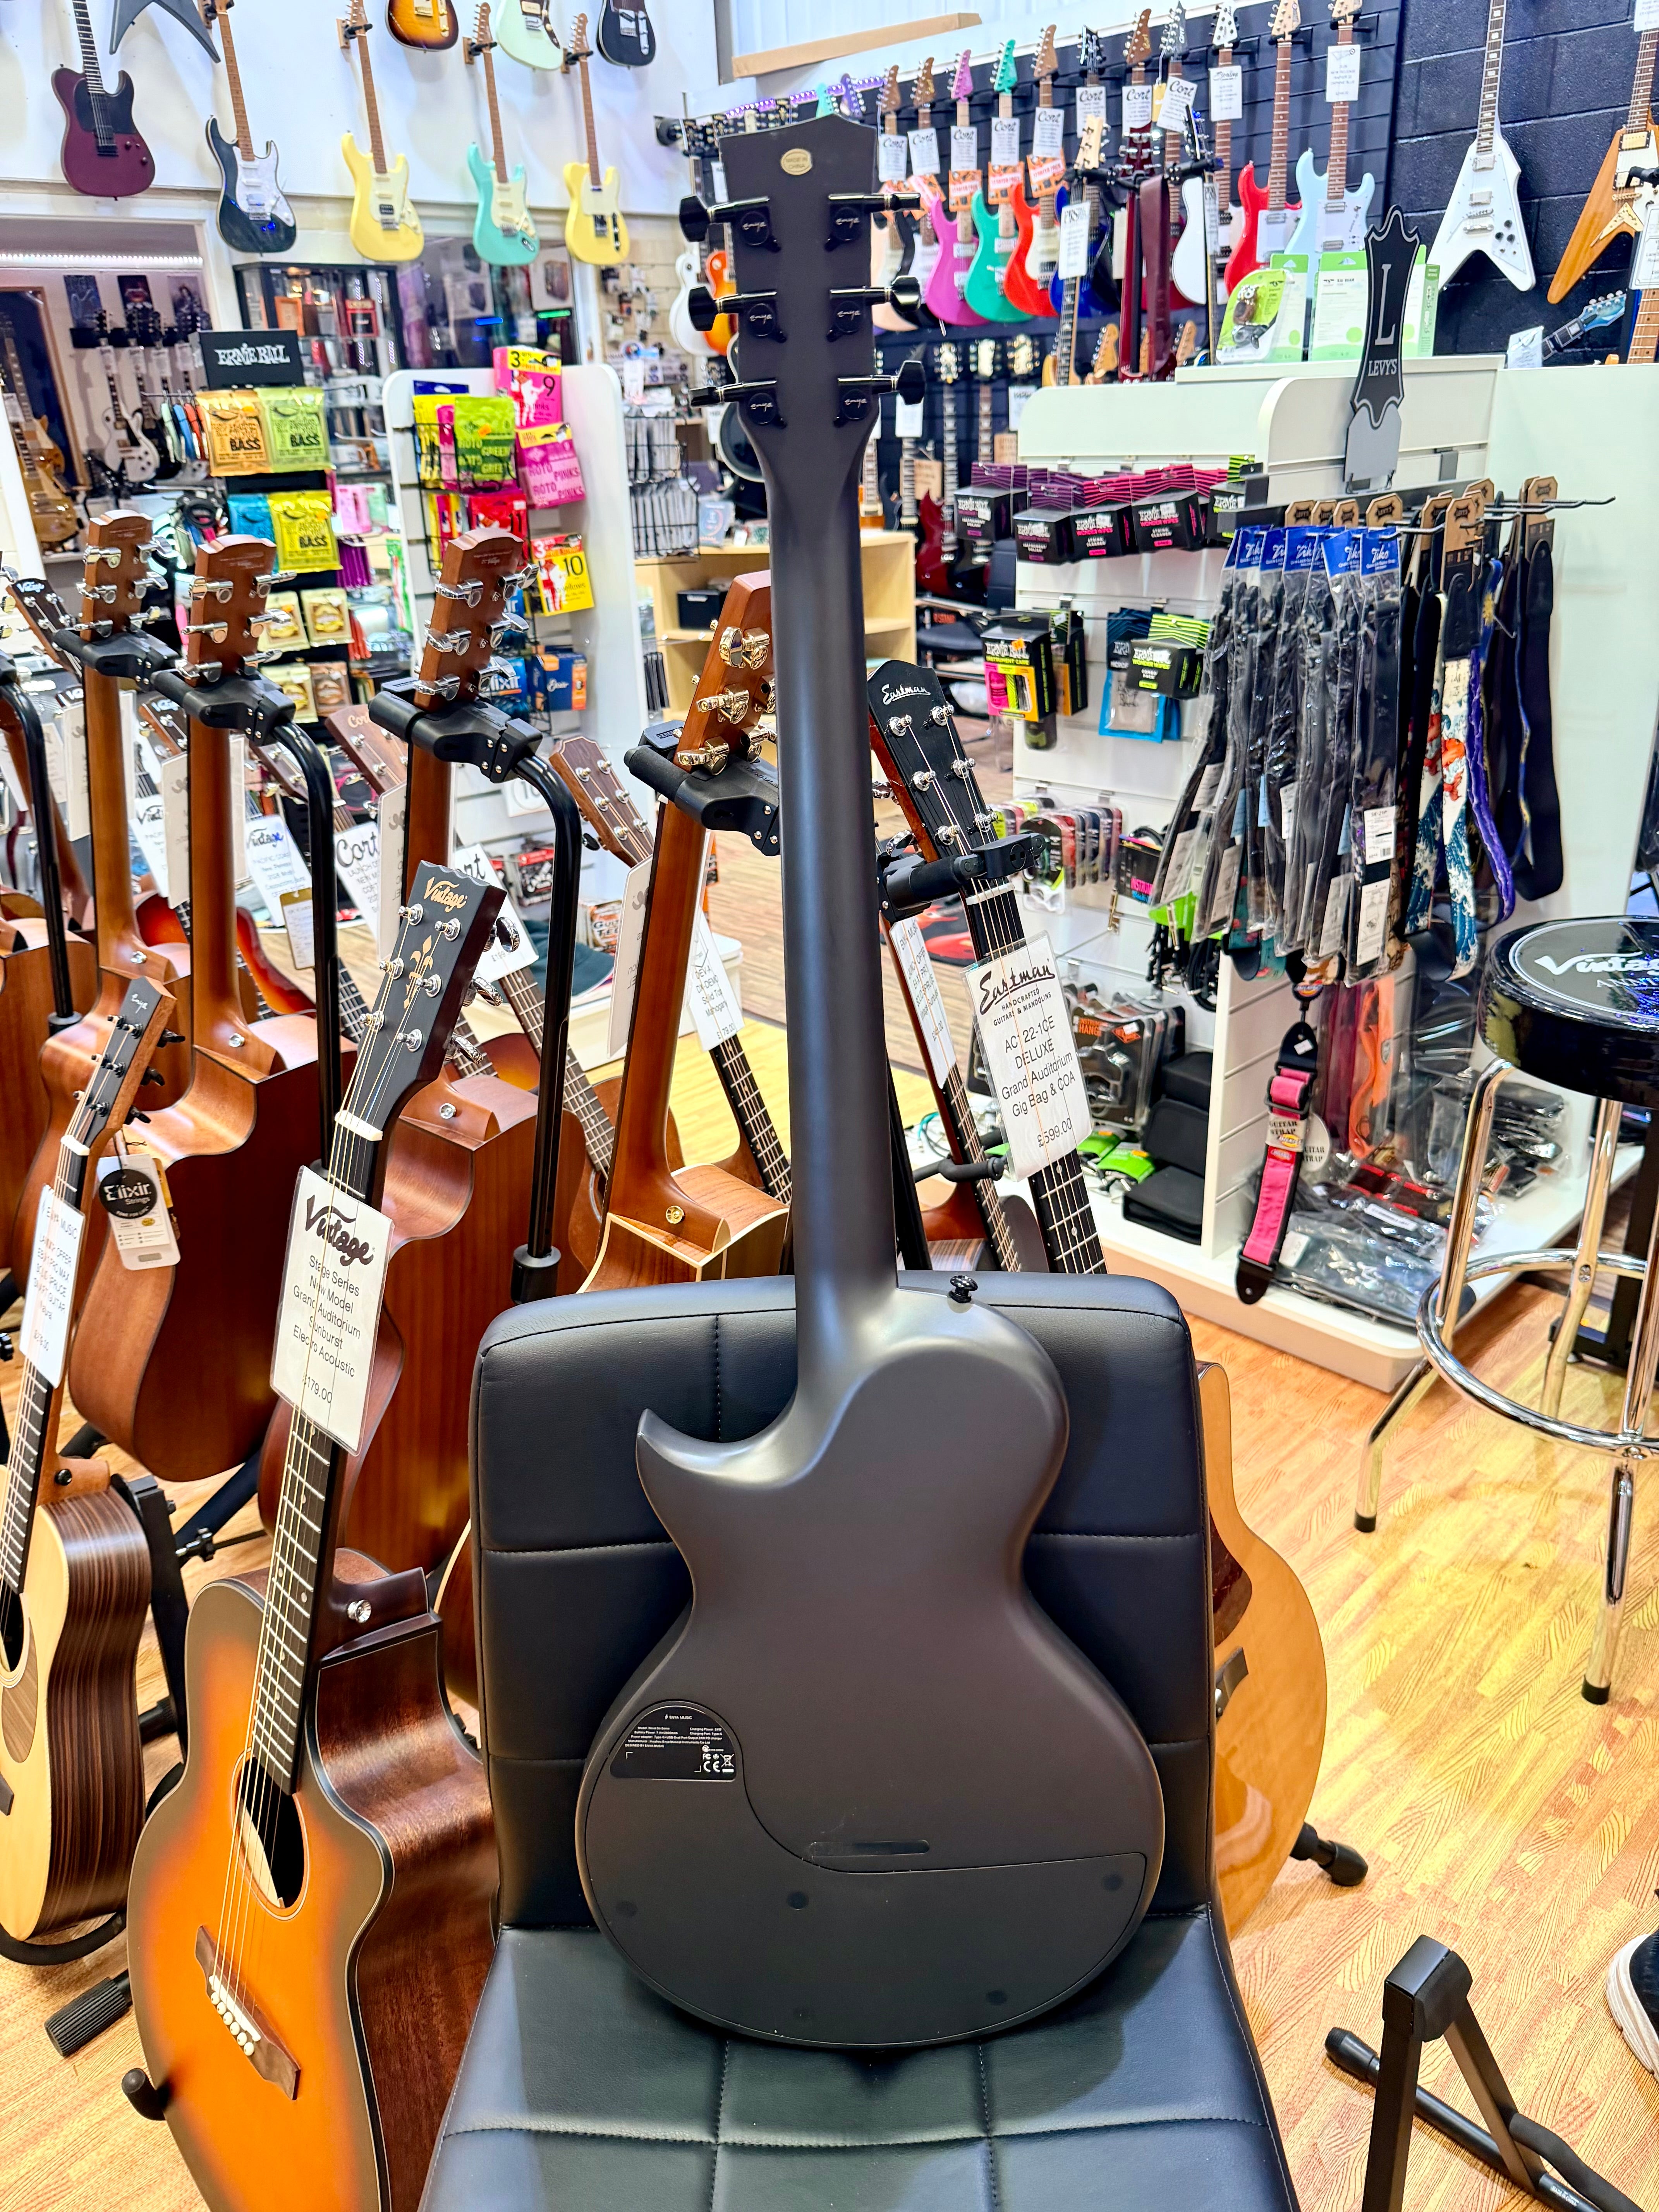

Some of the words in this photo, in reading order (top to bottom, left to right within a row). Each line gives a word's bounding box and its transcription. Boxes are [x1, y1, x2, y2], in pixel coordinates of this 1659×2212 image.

[1079, 89, 1104, 102] Cort
[1127, 88, 1150, 101] Cort
[1170, 80, 1194, 96] Cort
[994, 120, 1016, 132] Cort
[1038, 112, 1061, 122] Cort
[884, 138, 904, 148] Cort
[913, 132, 934, 145] Cort
[954, 128, 974, 141] Cort
[1375, 264, 1396, 345] L
[214, 343, 258, 366] ERNIE
[257, 344, 291, 364] BALL
[511, 351, 520, 367] 3
[1368, 359, 1398, 376] LEVY'S
[543, 376, 555, 397] 9
[230, 438, 261, 451] BASS
[290, 433, 320, 447] BASS
[299, 535, 328, 548] BASS
[534, 539, 546, 559] 3
[563, 555, 584, 577] 10
[984, 640, 1008, 658] ERNIE
[881, 684, 931, 705] Eastman
[337, 831, 380, 868] Cort
[424, 877, 468, 912] Vintage
[979, 962, 1056, 1015] Eastman
[993, 1009, 1015, 1026] GUITARS
[1023, 991, 1052, 1013] MANDOLINS
[1001, 988, 1040, 1011] HANDCRAFTED
[717, 1022, 736, 1040] £79.00
[1014, 1037, 1055, 1070] DELUXE
[1002, 1079, 1029, 1101] Grand
[1031, 1051, 1073, 1084] Auditorium
[1012, 1101, 1027, 1118] Gig
[1028, 1091, 1049, 1109] Bag
[1050, 1084, 1057, 1097] &
[1058, 1071, 1076, 1091] COA
[1037, 1117, 1073, 1149] £599.00
[305, 1194, 374, 1267] Vintage
[309, 1255, 331, 1281] Stage
[332, 1272, 359, 1297] Series
[309, 1274, 326, 1296] New
[327, 1288, 354, 1315] Model
[293, 1285, 316, 1310] Grand
[318, 1300, 361, 1340] Auditorium
[309, 1315, 343, 1350] Sunburst
[293, 1325, 318, 1352] Electro
[319, 1348, 356, 1378] Acoustic
